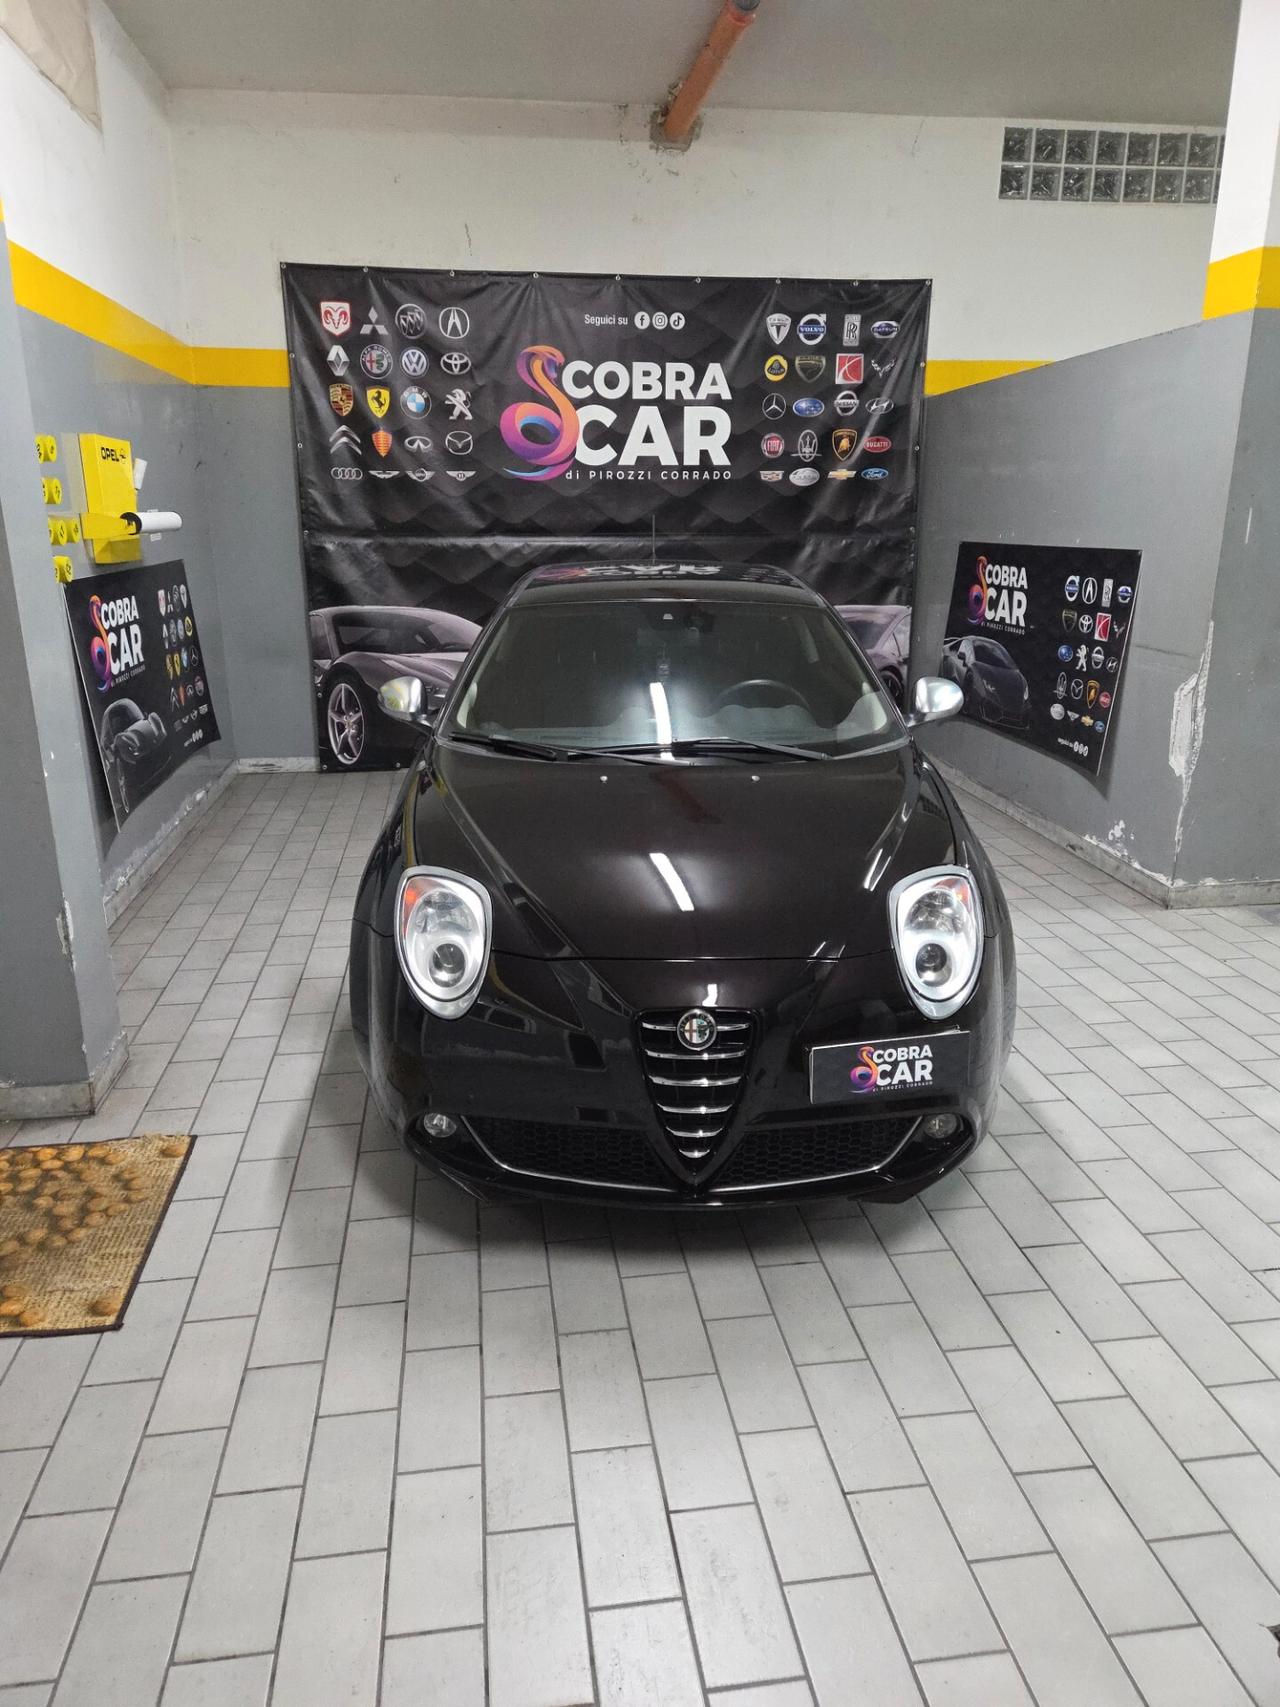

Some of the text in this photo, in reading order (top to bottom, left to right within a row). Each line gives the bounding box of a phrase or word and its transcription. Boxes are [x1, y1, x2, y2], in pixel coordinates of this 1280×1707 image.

[584, 314, 629, 326] Seguici su
[562, 360, 732, 400] COBRA
[575, 404, 732, 466] CAR
[101, 446, 120, 462] OPEL
[565, 470, 732, 480] di PIROZZI CORRADO
[985, 563, 1028, 590] COBRA
[101, 596, 139, 630] COBRA
[984, 587, 1027, 627] CAR
[108, 624, 144, 675] CAR
[872, 1044, 933, 1064] COBRA
[876, 1059, 933, 1086] CAR
